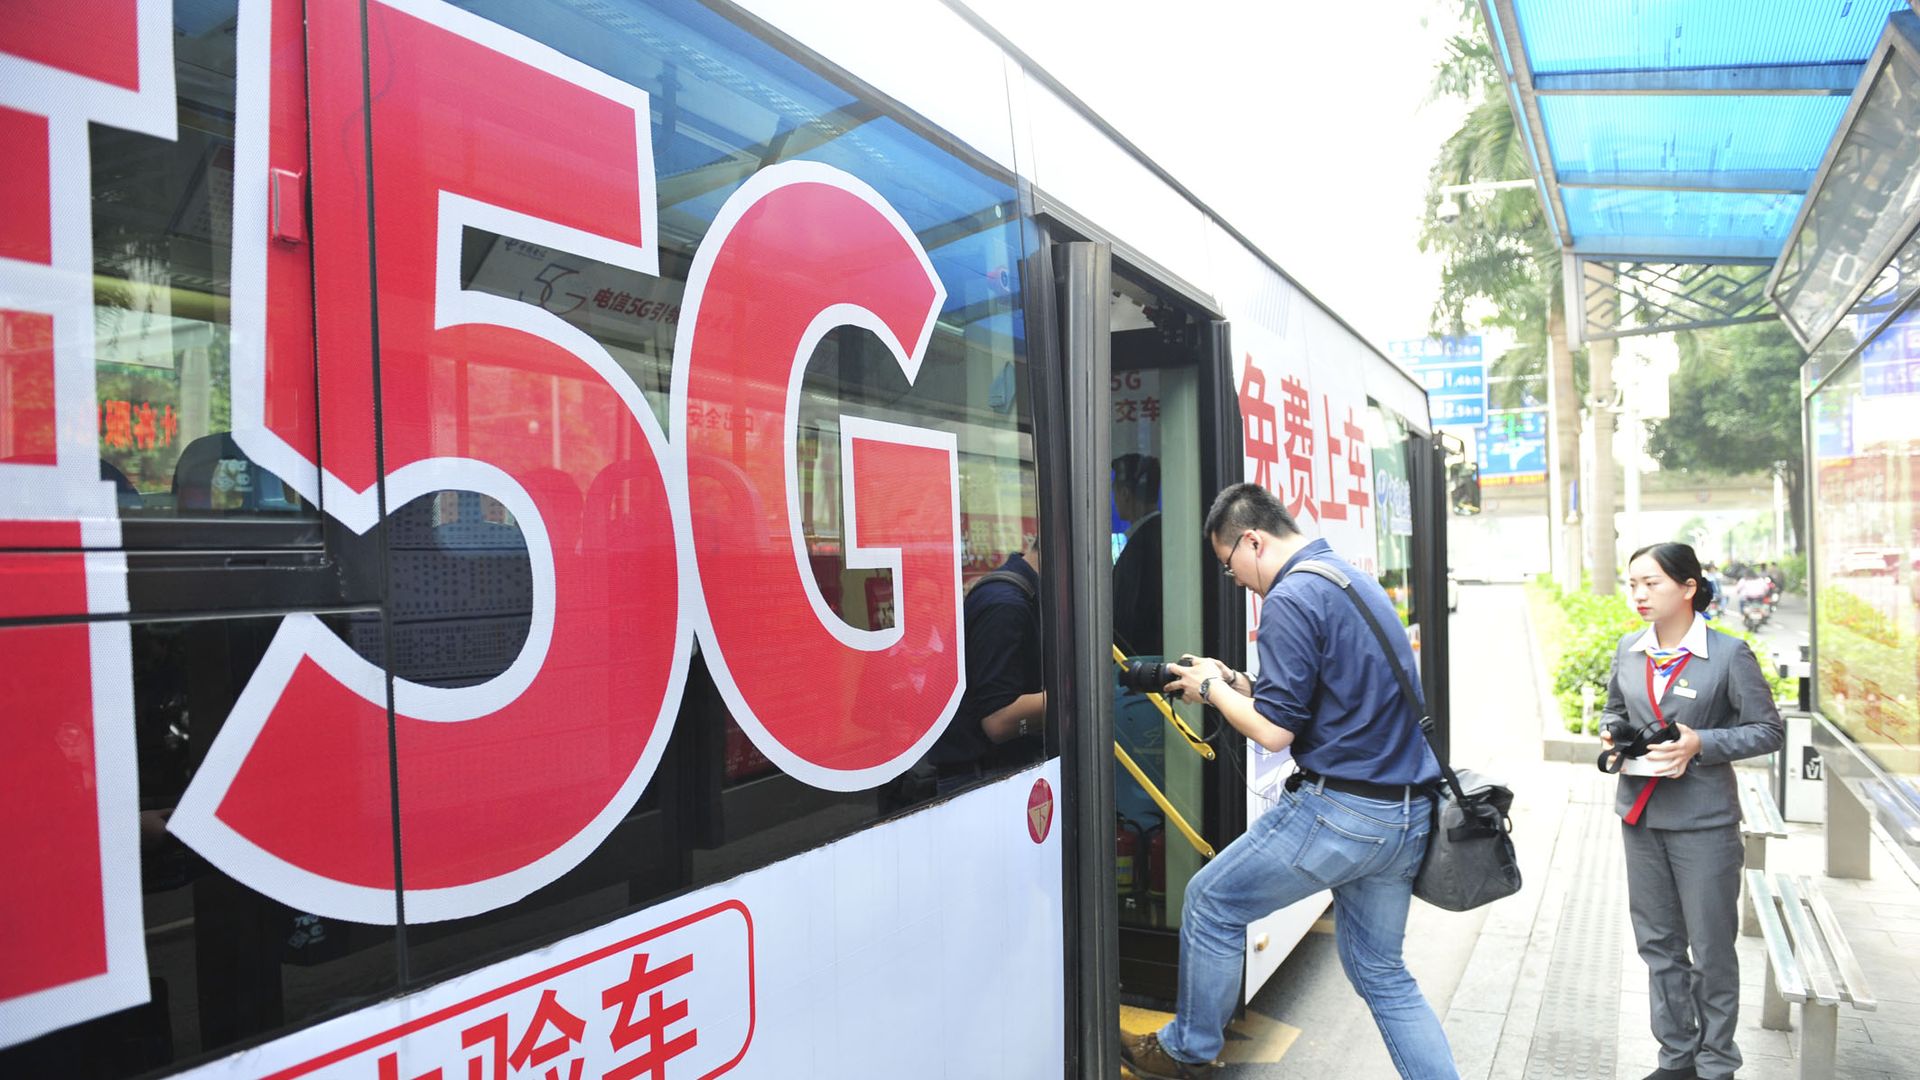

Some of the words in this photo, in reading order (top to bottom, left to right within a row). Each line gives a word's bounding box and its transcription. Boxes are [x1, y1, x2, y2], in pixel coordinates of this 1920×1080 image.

[1239, 352, 1370, 529] 免费上车
[378, 953, 698, 1080] 验车
